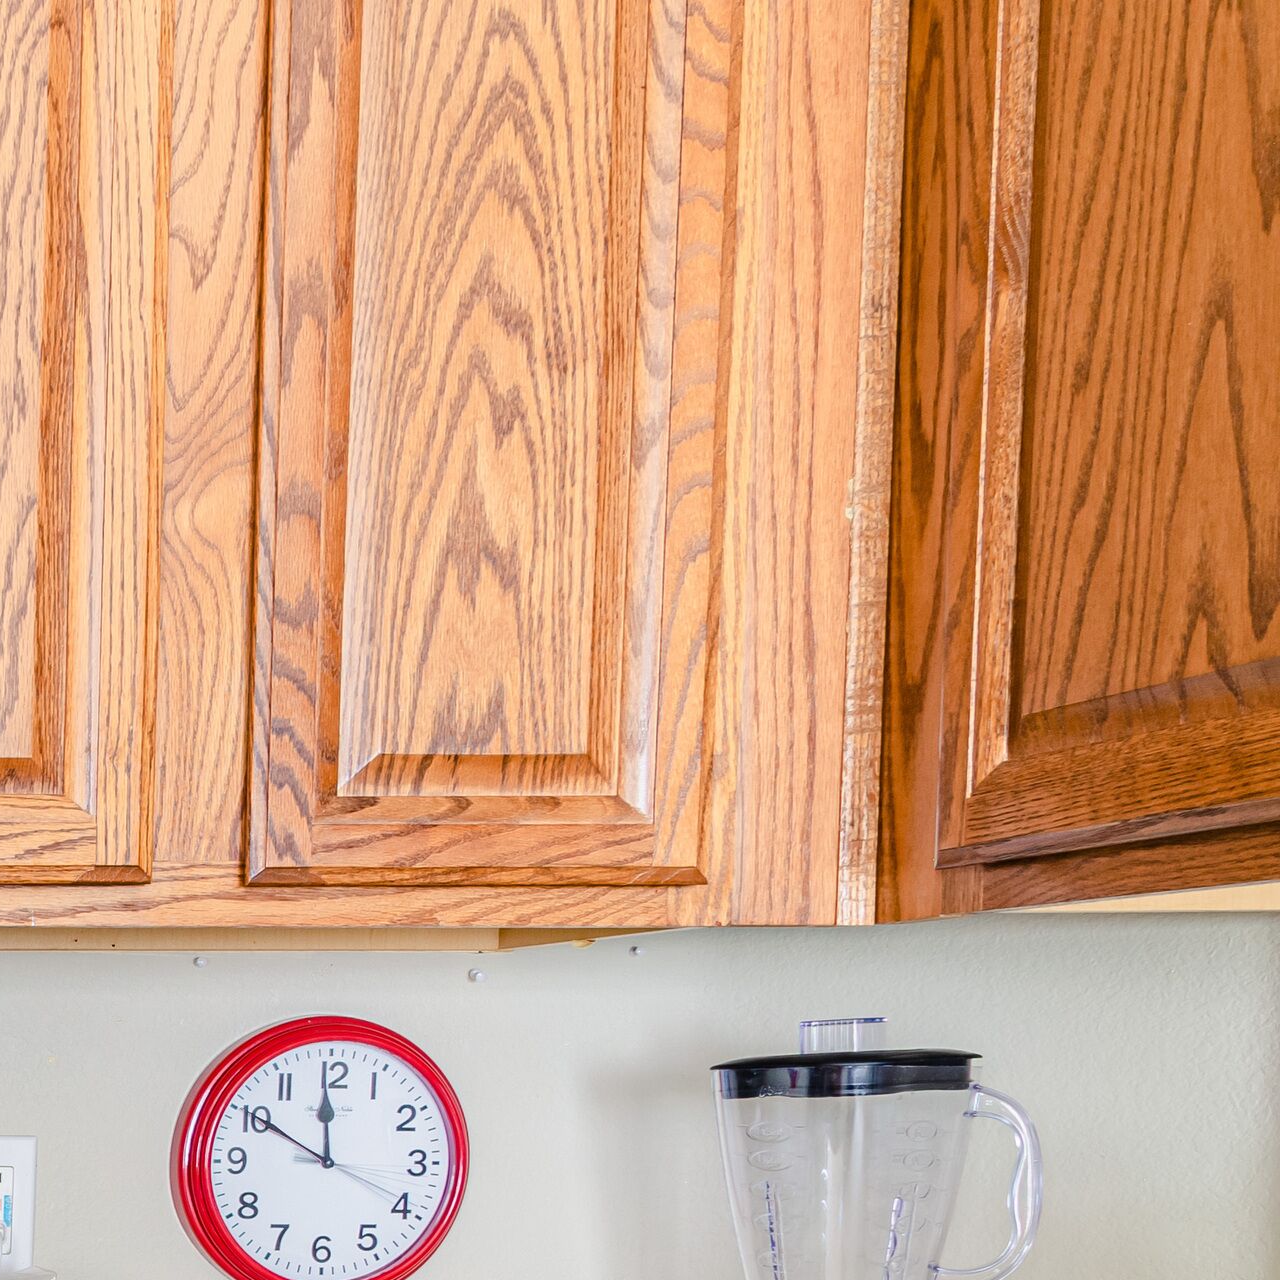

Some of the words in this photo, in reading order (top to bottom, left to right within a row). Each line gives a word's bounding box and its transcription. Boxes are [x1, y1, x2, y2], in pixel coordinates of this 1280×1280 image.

[370, 1072, 377, 1100] 1
[242, 1104, 271, 1133] 10
[395, 1103, 417, 1132] 2
[227, 1147, 247, 1175] 9
[406, 1149, 428, 1177] 3
[237, 1191, 259, 1220] 8
[390, 1192, 412, 1220] 4
[270, 1223, 290, 1250] 7
[311, 1235, 332, 1263] 6
[356, 1224, 378, 1251] 5
